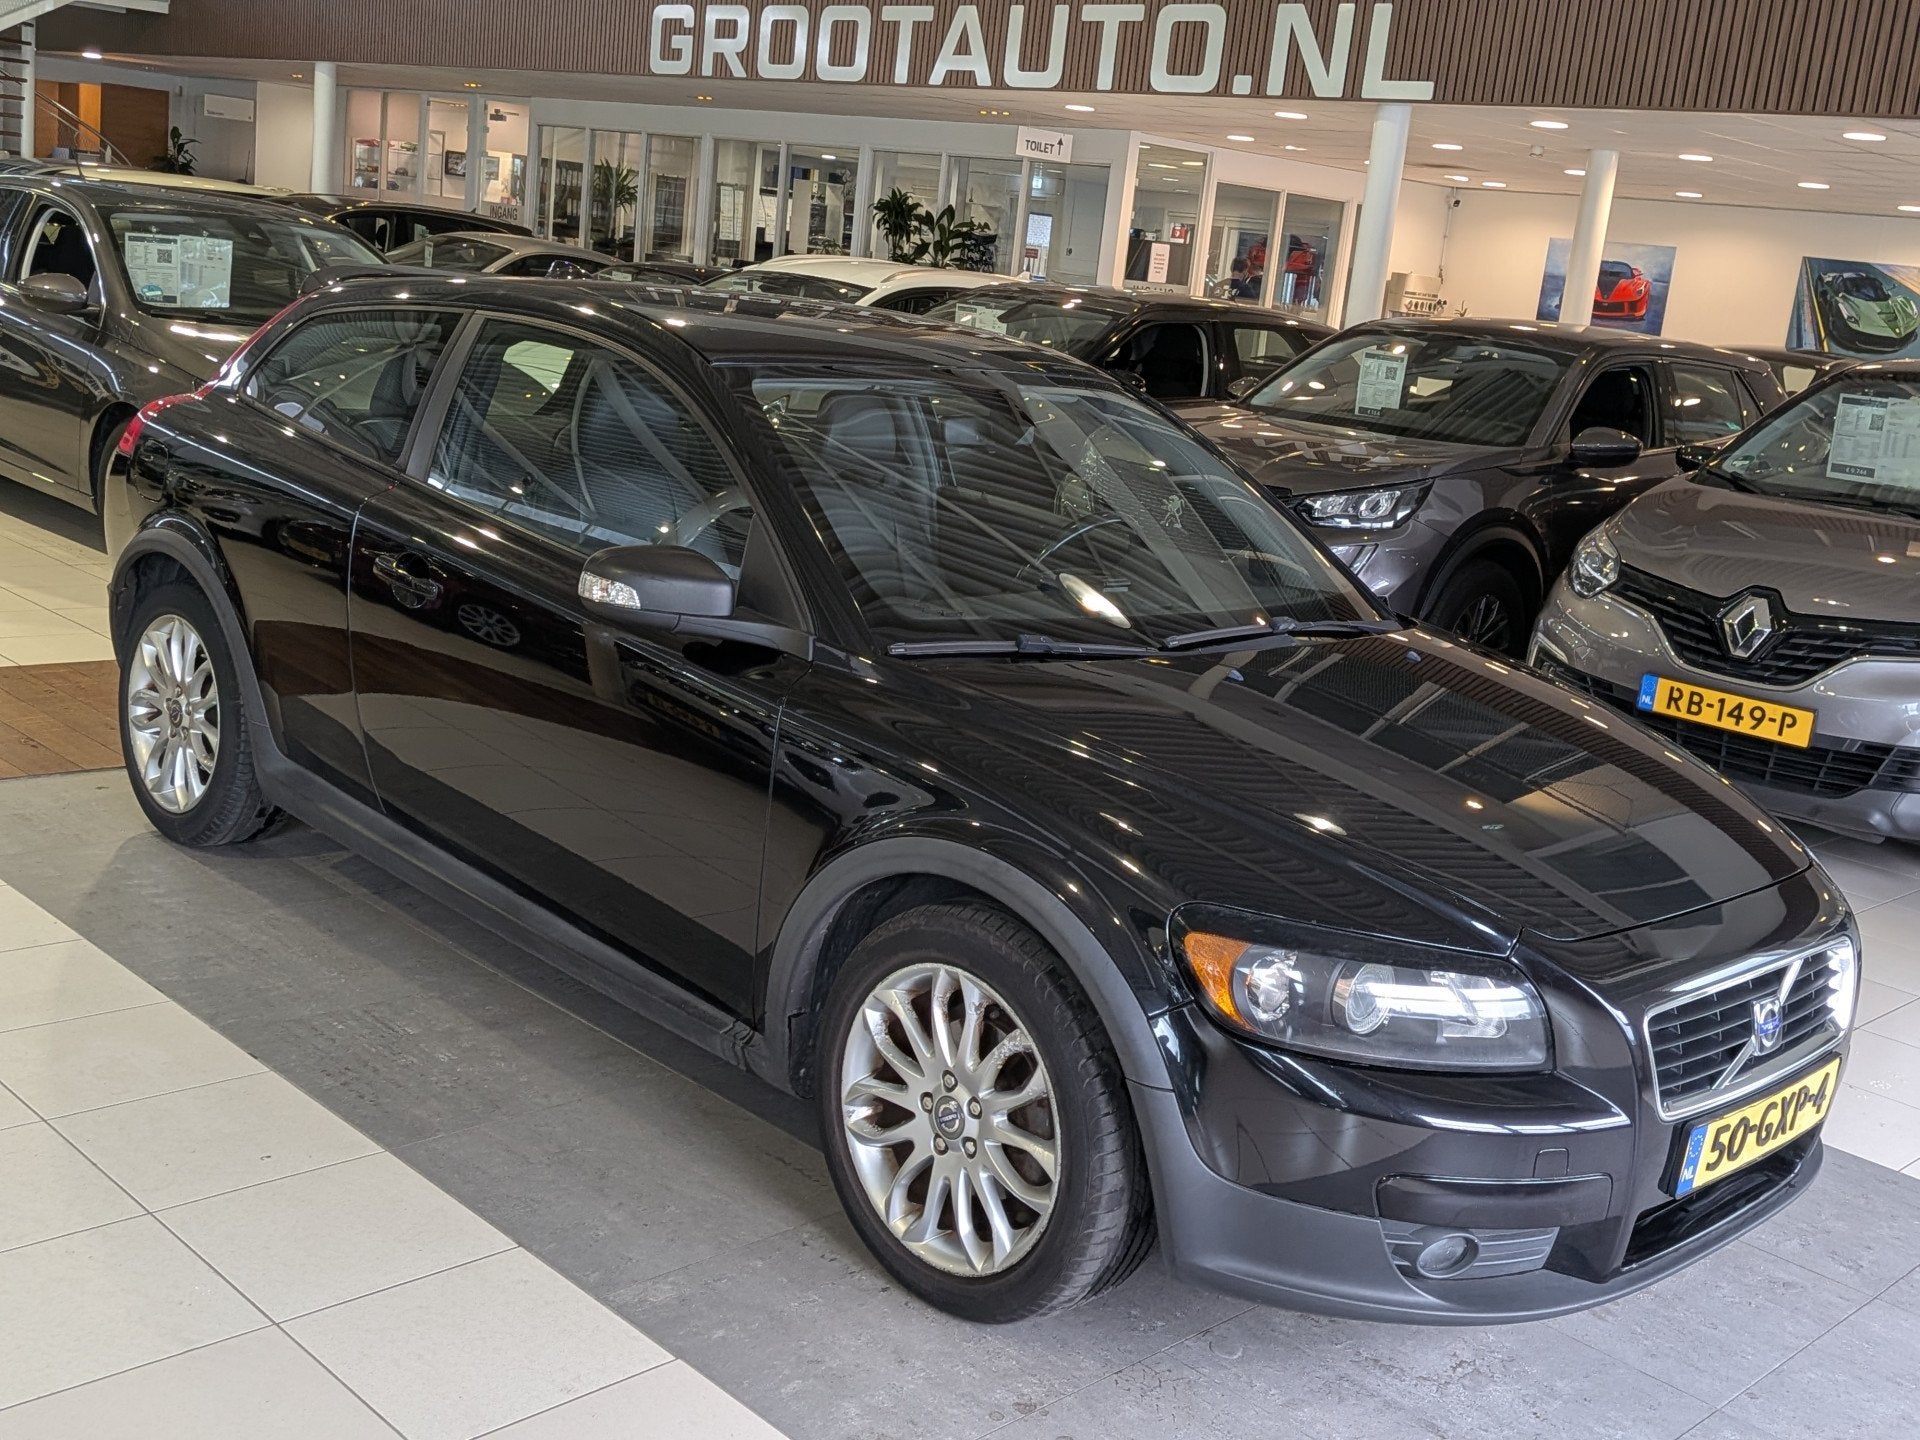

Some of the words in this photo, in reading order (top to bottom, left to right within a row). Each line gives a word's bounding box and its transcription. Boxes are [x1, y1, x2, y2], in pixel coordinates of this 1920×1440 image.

[649, 3, 1434, 100] GROOTAUTO.NL
[1025, 139, 1055, 155] TOILET
[490, 204, 518, 221] INGANG
[1641, 695, 1653, 705] NL
[1666, 685, 1798, 737] RB-149-P
[1761, 1019, 1779, 1030] VOL
[1705, 1071, 1831, 1172] 50-GXP-4
[1680, 1165, 1695, 1183] NL
